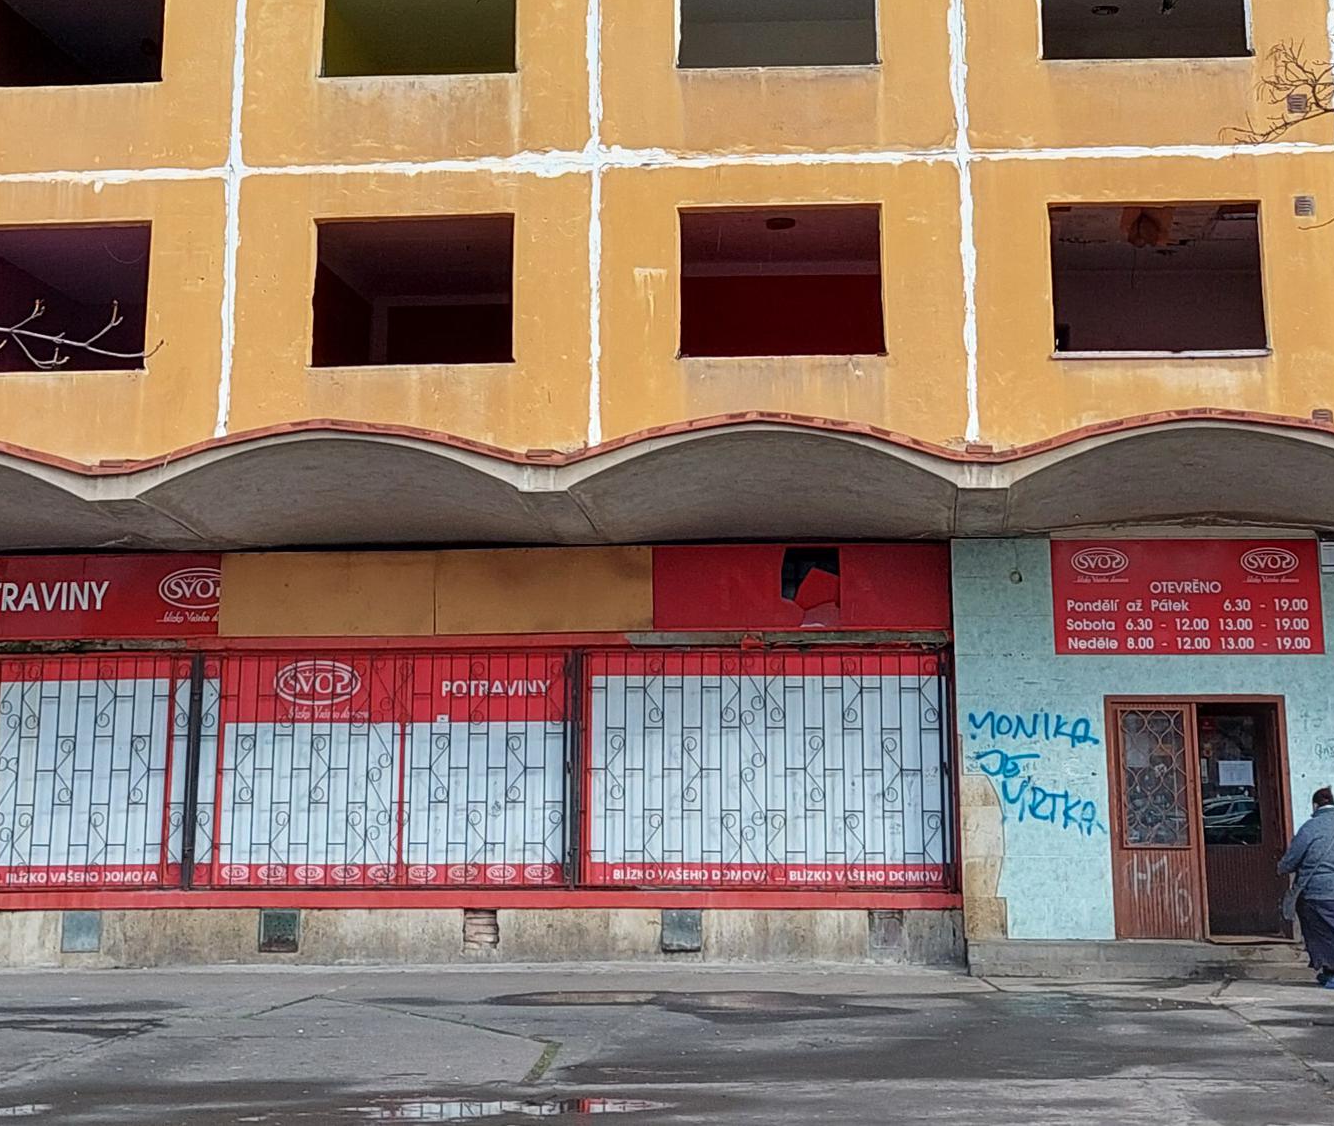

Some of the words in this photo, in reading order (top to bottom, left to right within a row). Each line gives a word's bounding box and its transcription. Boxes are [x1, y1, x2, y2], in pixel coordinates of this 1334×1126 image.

[1067, 598, 1118, 612] Pondělí
[1126, 598, 1143, 612] až
[1151, 598, 1189, 612] Pátek
[1223, 599, 1251, 612] 6.30
[1274, 598, 1309, 611] 19.00
[1066, 618, 1116, 631] Sobota
[1125, 618, 1153, 631] 6.30
[1175, 618, 1209, 631] 12.00
[1219, 618, 1253, 631] 13.00
[1275, 618, 1310, 631] 19.00
[1068, 636, 1118, 650] Neděle
[1127, 637, 1154, 650] 8.00
[1177, 637, 1211, 650] 12.00
[1220, 637, 1255, 650] 13.00
[1276, 637, 1311, 650] 19.00
[442, 680, 550, 697] POTRAVINY
[969, 711, 1099, 747] MONIKA
